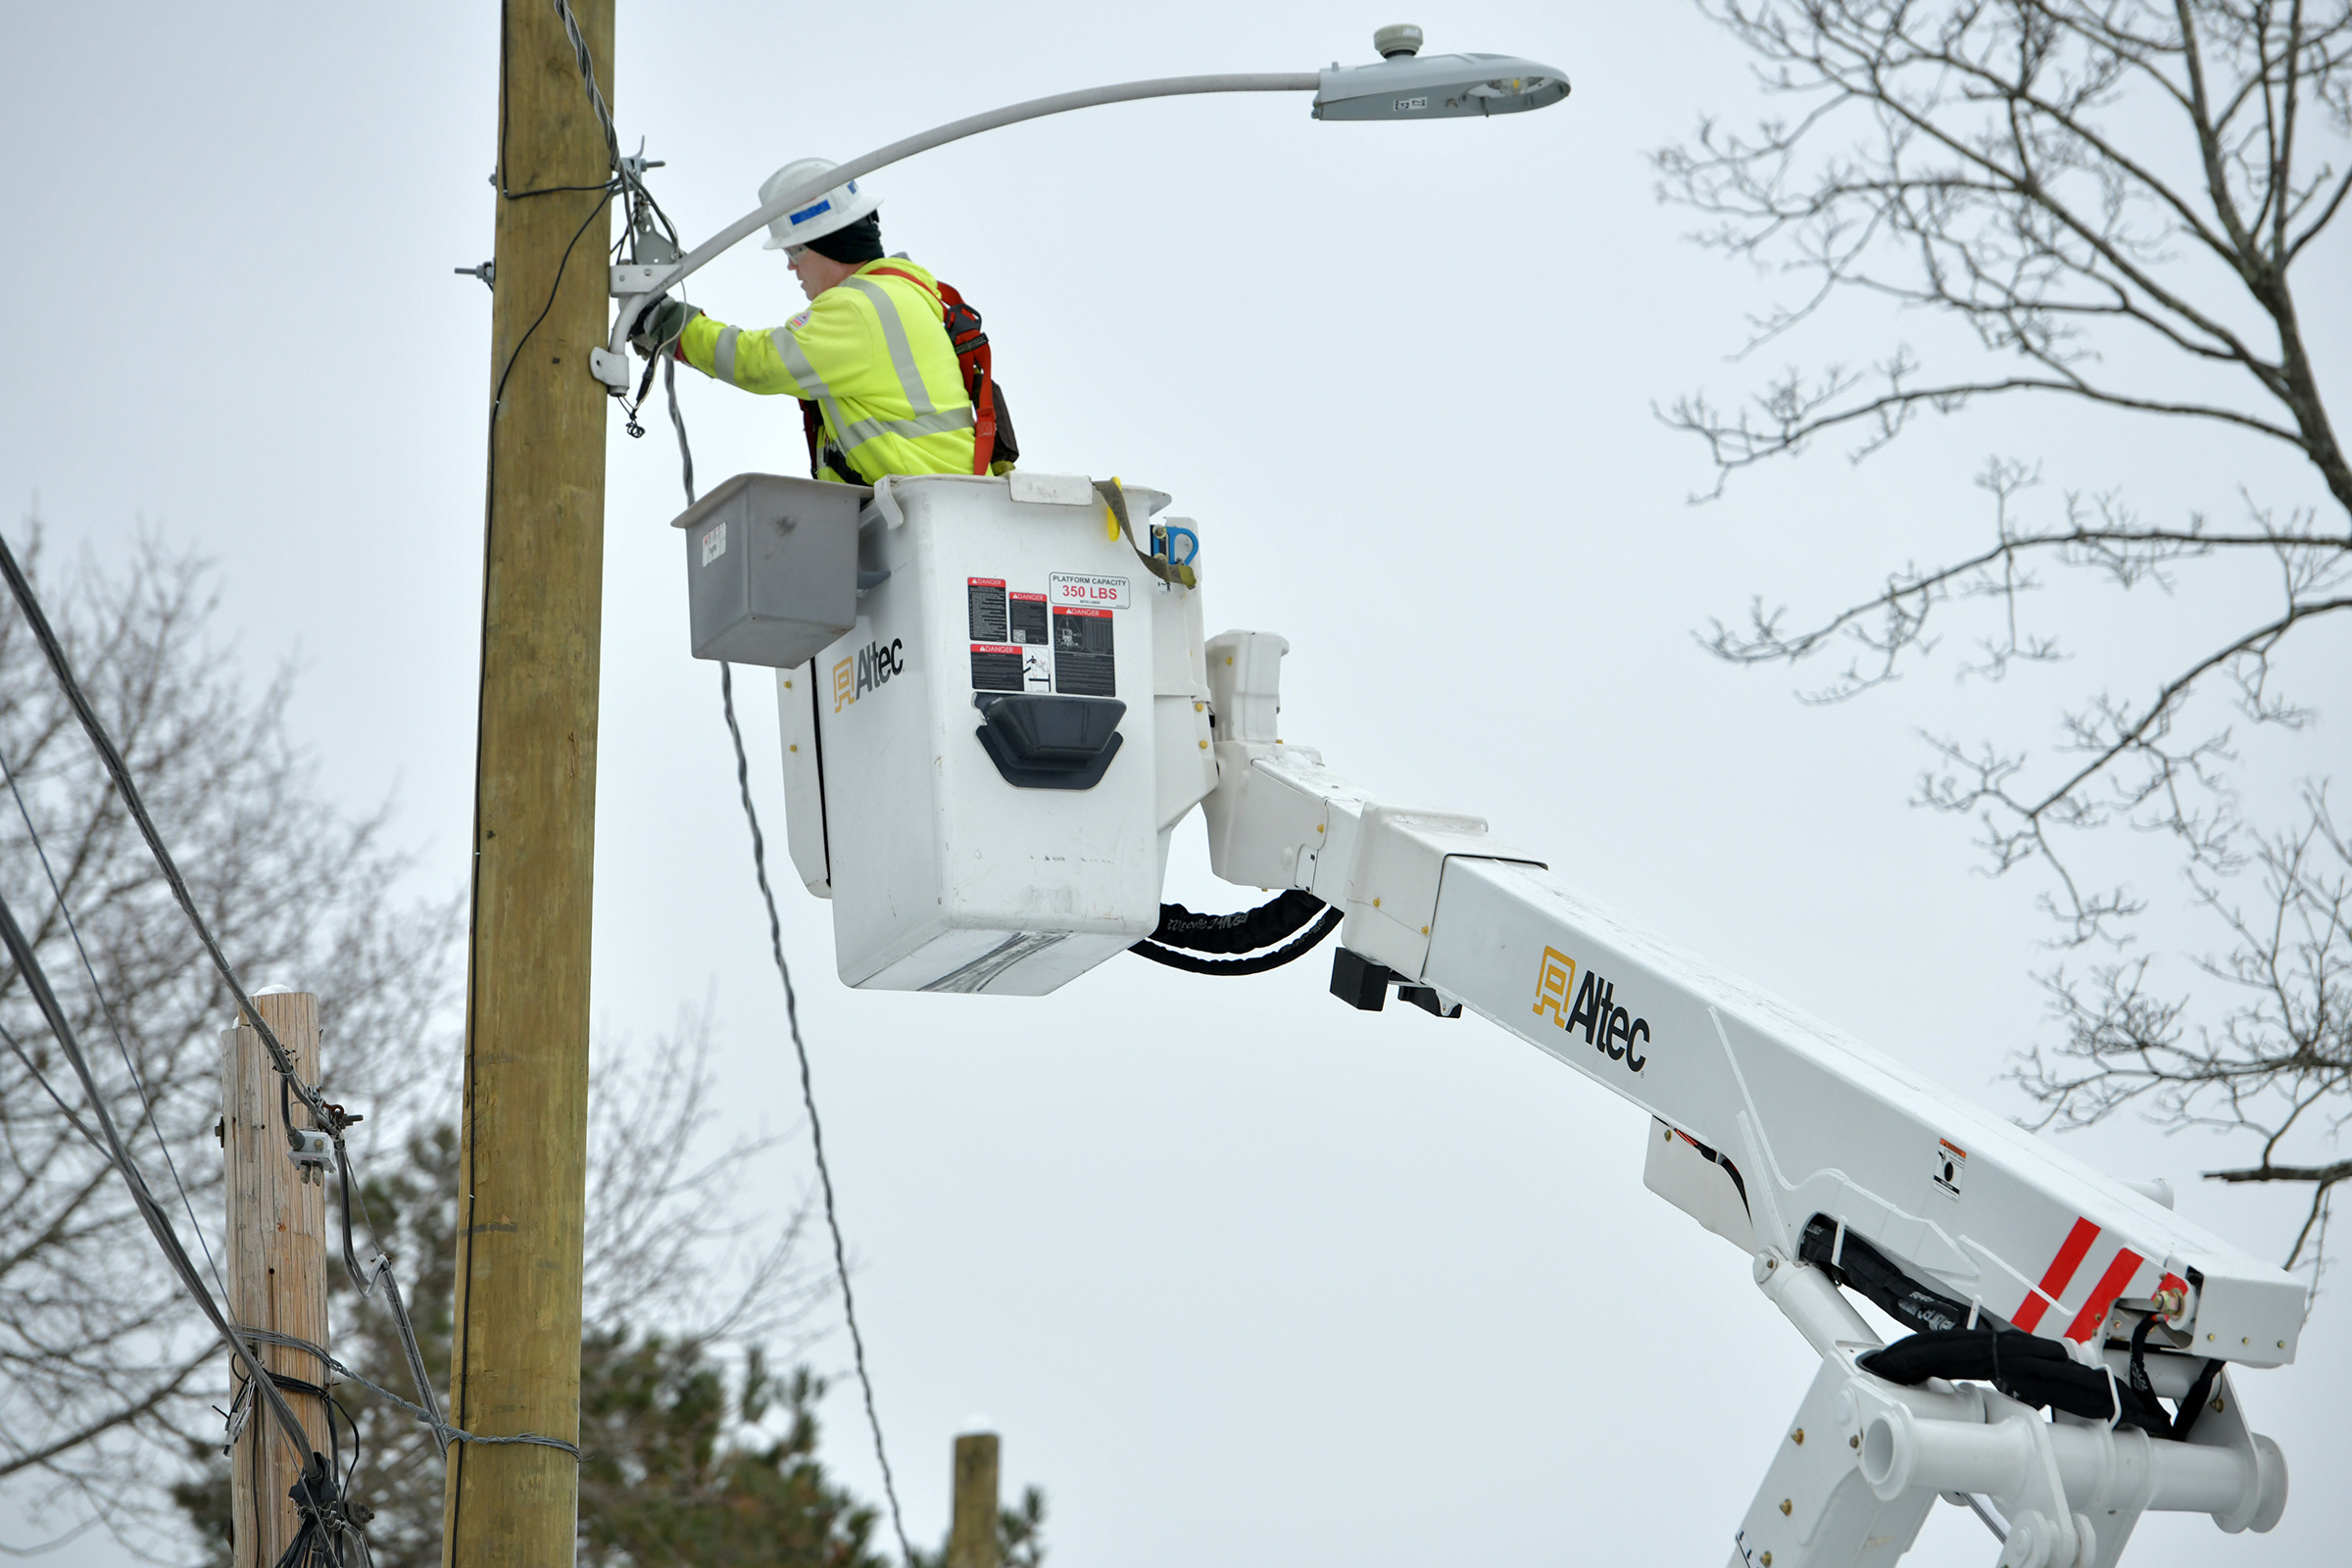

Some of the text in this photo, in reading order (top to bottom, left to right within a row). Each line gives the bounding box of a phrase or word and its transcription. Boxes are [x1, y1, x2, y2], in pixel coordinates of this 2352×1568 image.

[1062, 585, 1117, 600] 350 LBS
[1071, 608, 1100, 616] DANGER
[985, 645, 1013, 654] DANGER
[856, 638, 904, 701] Altec
[1565, 970, 1650, 1072] Altec
